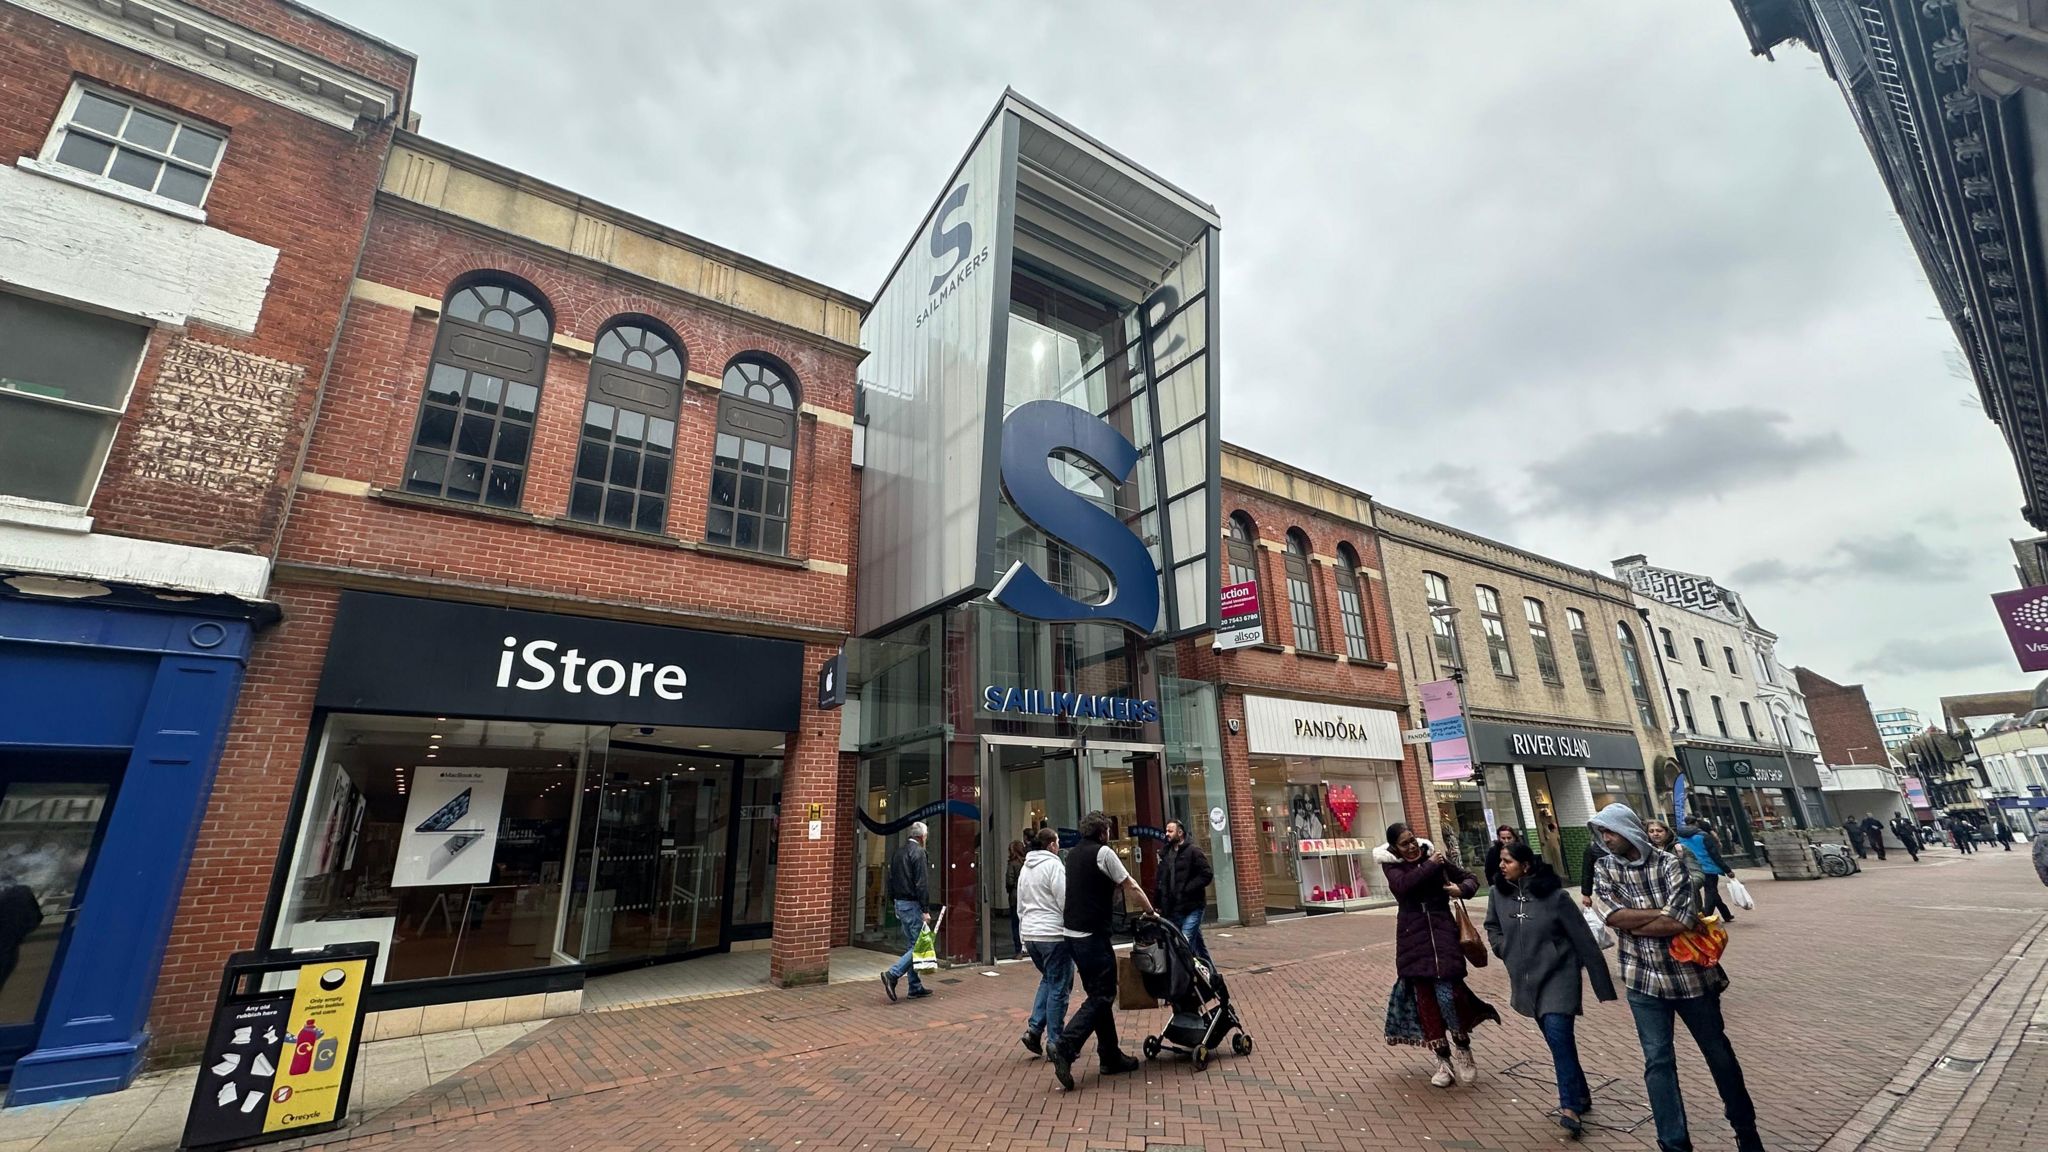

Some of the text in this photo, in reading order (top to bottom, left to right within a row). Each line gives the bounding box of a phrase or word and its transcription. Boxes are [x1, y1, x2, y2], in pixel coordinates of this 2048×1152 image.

[929, 183, 973, 296] S
[916, 246, 989, 329] SAILMAKERS
[171, 346, 295, 388] PERMANENT
[176, 366, 288, 406] WAVING
[987, 399, 1160, 638] S
[1221, 587, 1249, 600] uction
[1234, 631, 1261, 642] allsop
[2025, 643, 2048, 653] Vis
[496, 636, 688, 701] iStore
[984, 685, 1159, 723] SAILMAKERS
[1294, 716, 1368, 742] PANDORA
[1512, 733, 1591, 758] RIVER ISLAND
[1768, 769, 1783, 781] SHOP
[236, 1011, 262, 1019] rubbish
[245, 1004, 259, 1012] Any
[304, 1003, 325, 1011] plastic
[294, 1111, 321, 1122] recycle
